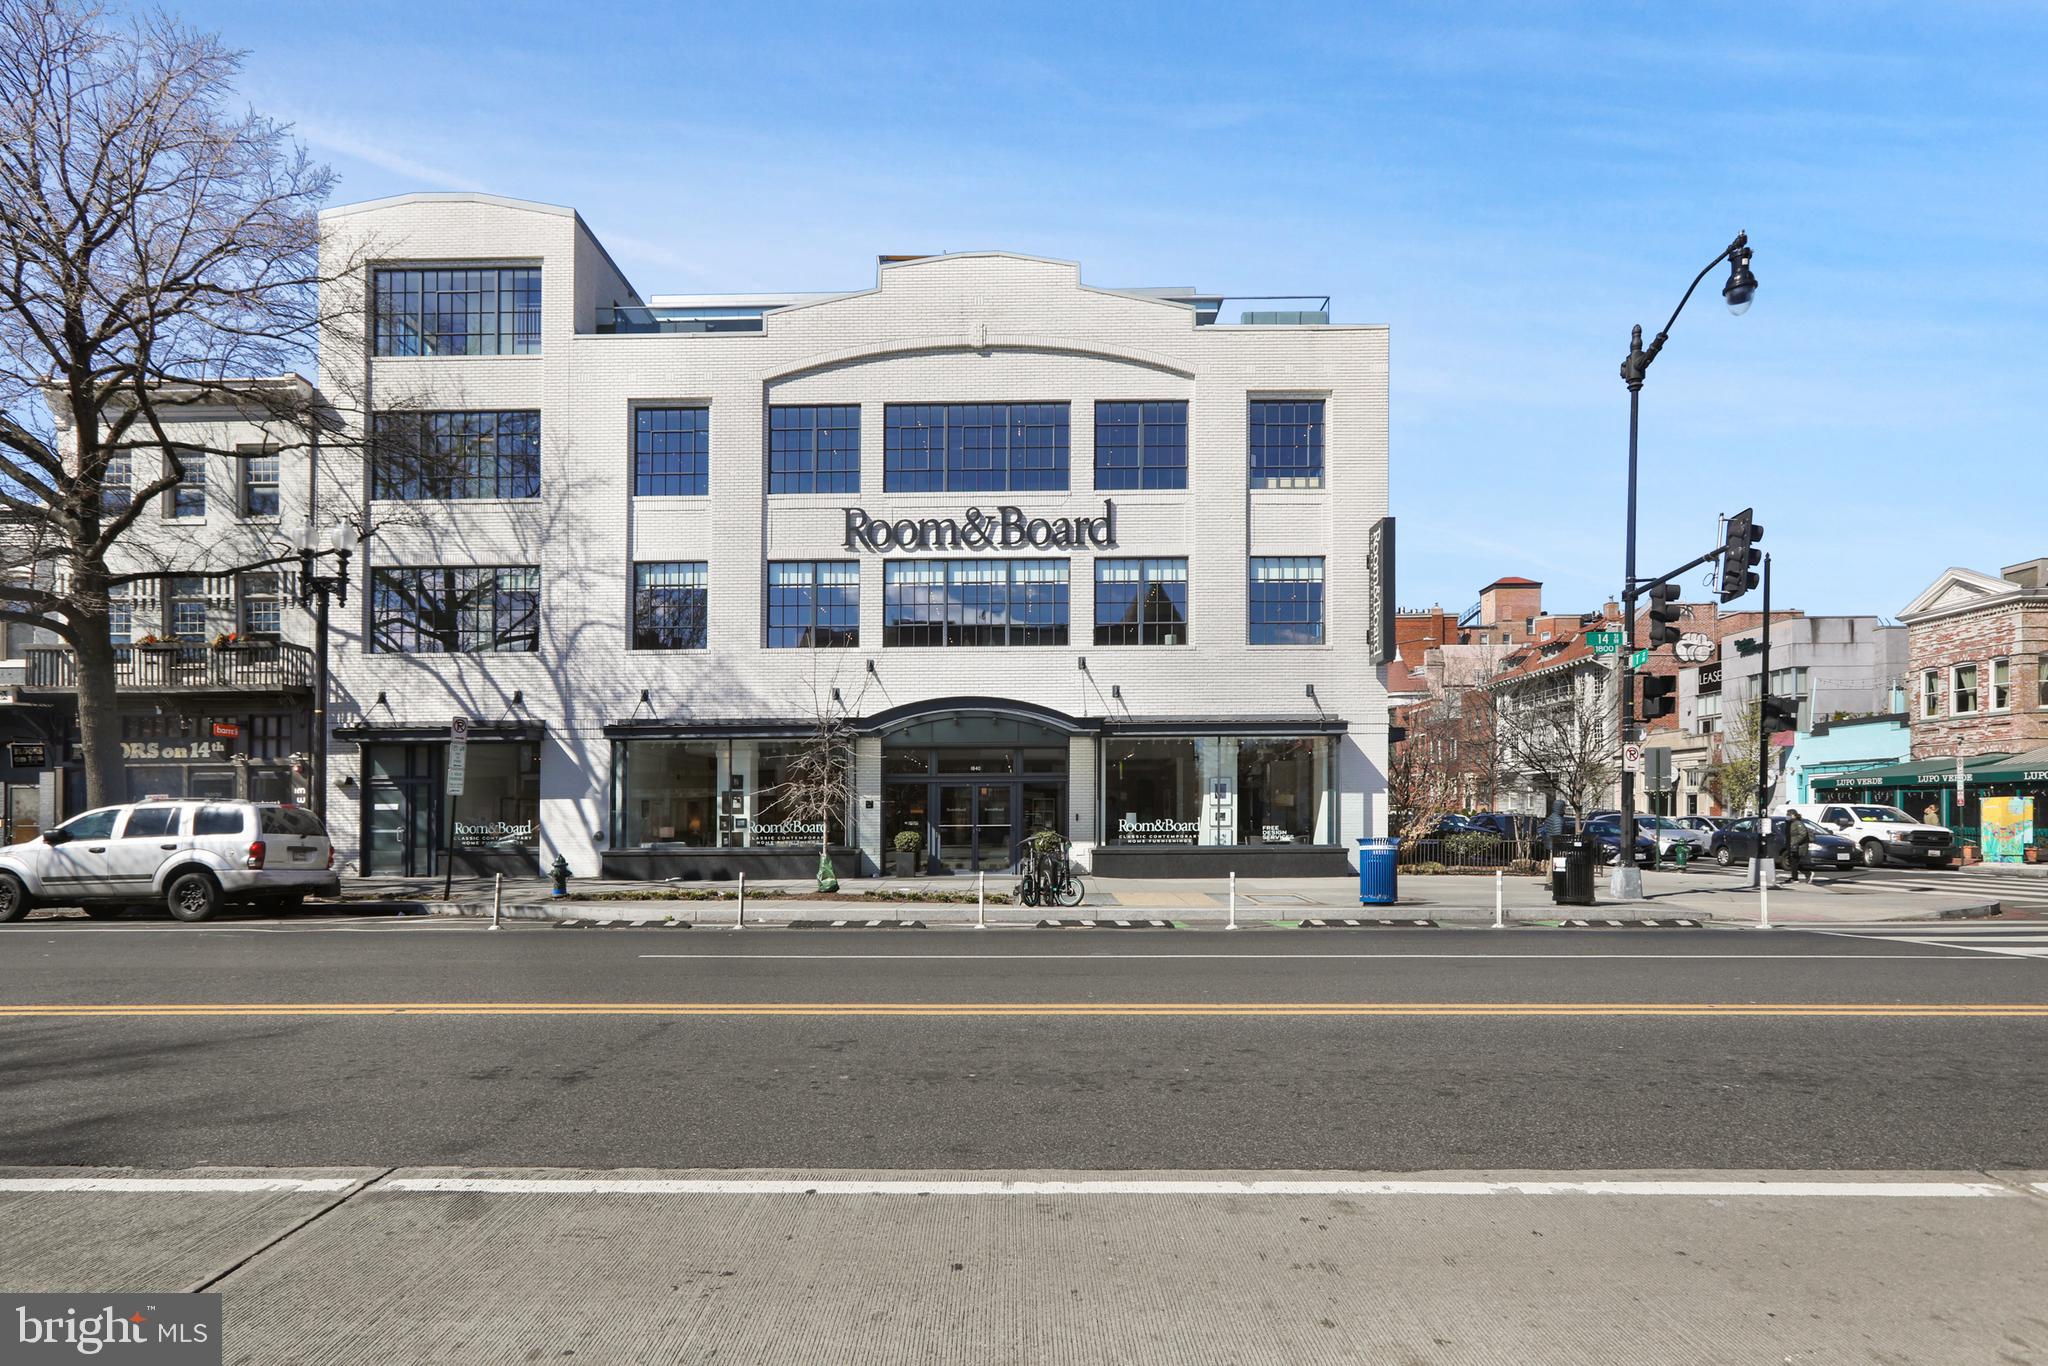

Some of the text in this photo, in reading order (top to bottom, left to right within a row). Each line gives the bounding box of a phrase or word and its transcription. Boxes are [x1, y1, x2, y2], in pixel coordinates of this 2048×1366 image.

[841, 498, 1117, 548] Room&Board
[1373, 527, 1382, 657] Room&Board
[1598, 633, 1609, 644] 14
[1595, 645, 1615, 653] 1800
[1699, 669, 1722, 685] LEASE
[161, 747, 188, 759] on
[190, 741, 225, 758] 14th
[1836, 777, 1883, 786] LUPO VERDE
[1917, 774, 1940, 783] LUPO
[454, 819, 532, 835] Room&Board
[1118, 816, 1200, 832] Room&Board
